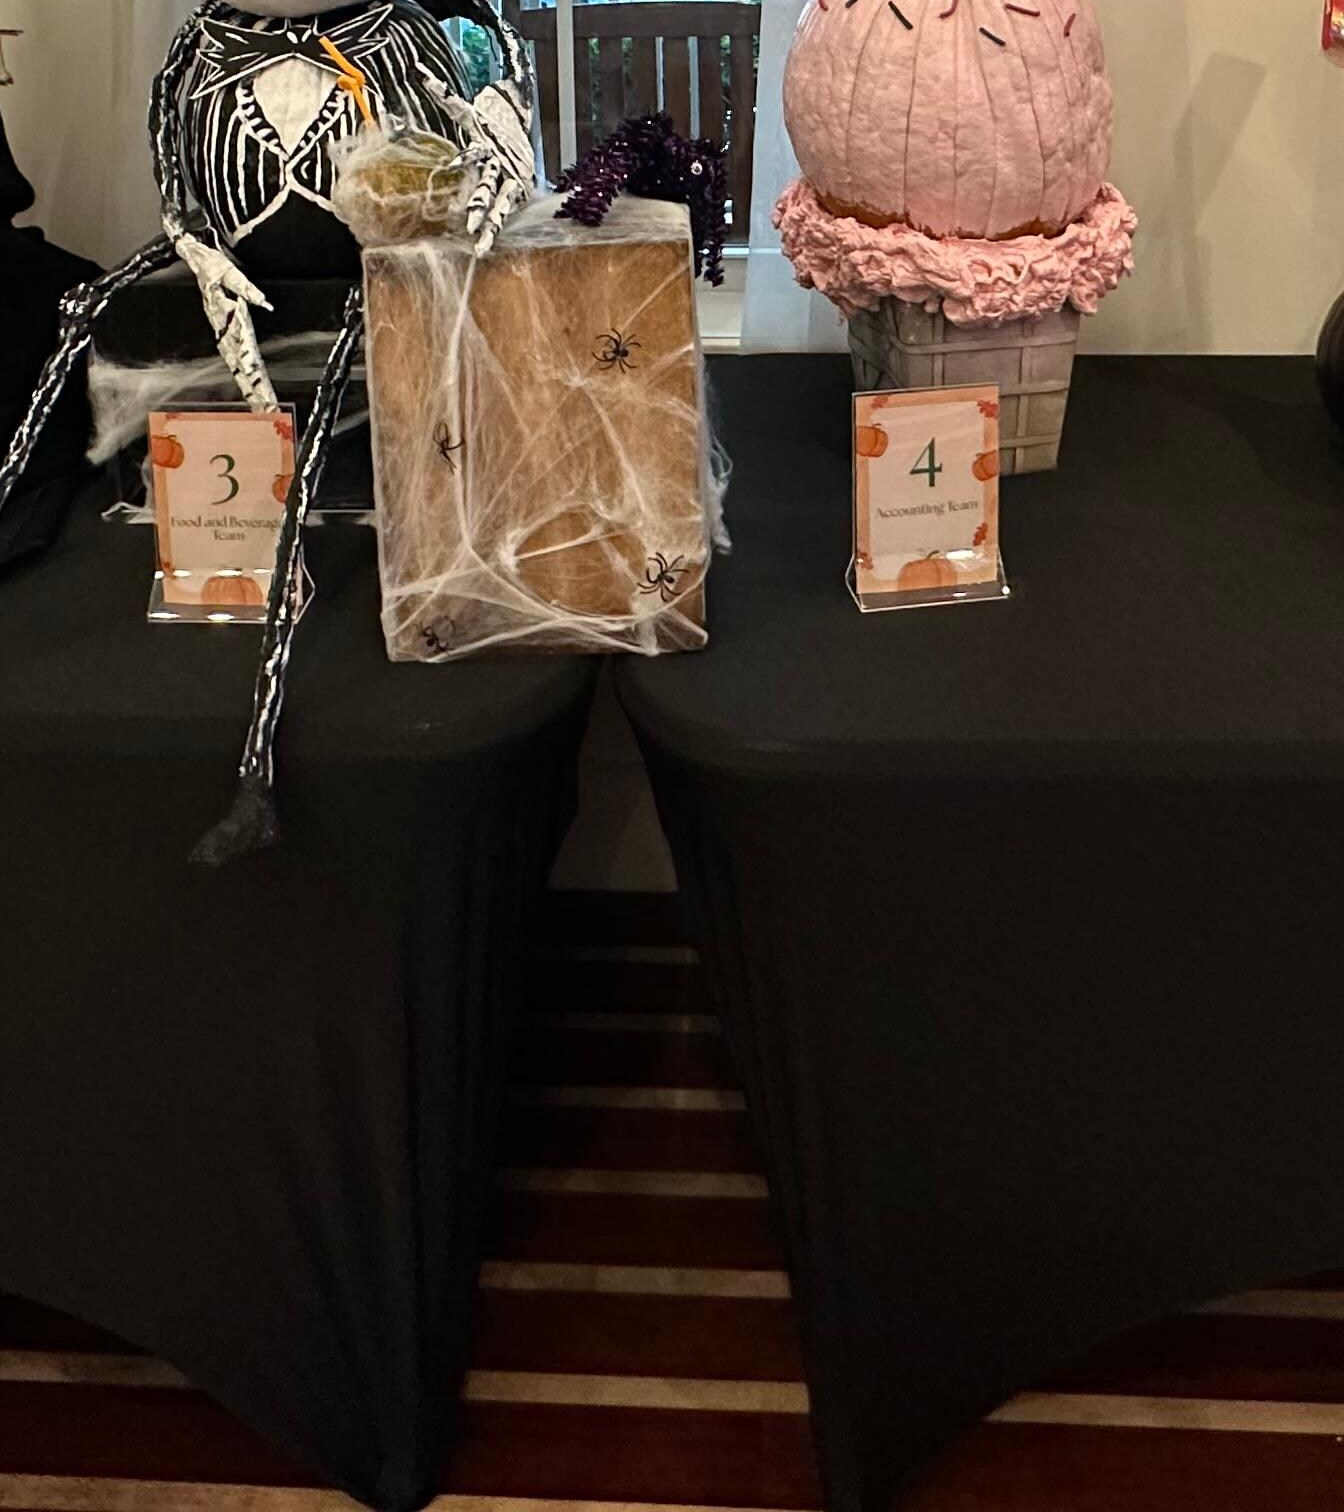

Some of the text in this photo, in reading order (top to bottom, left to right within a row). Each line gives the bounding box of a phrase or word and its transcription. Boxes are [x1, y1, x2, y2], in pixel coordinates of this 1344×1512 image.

[909, 438, 943, 488] 4
[209, 454, 240, 505] 3
[876, 500, 978, 519] Accounting Team
[171, 514, 282, 533] Food and Beverag
[214, 529, 246, 542] Team
